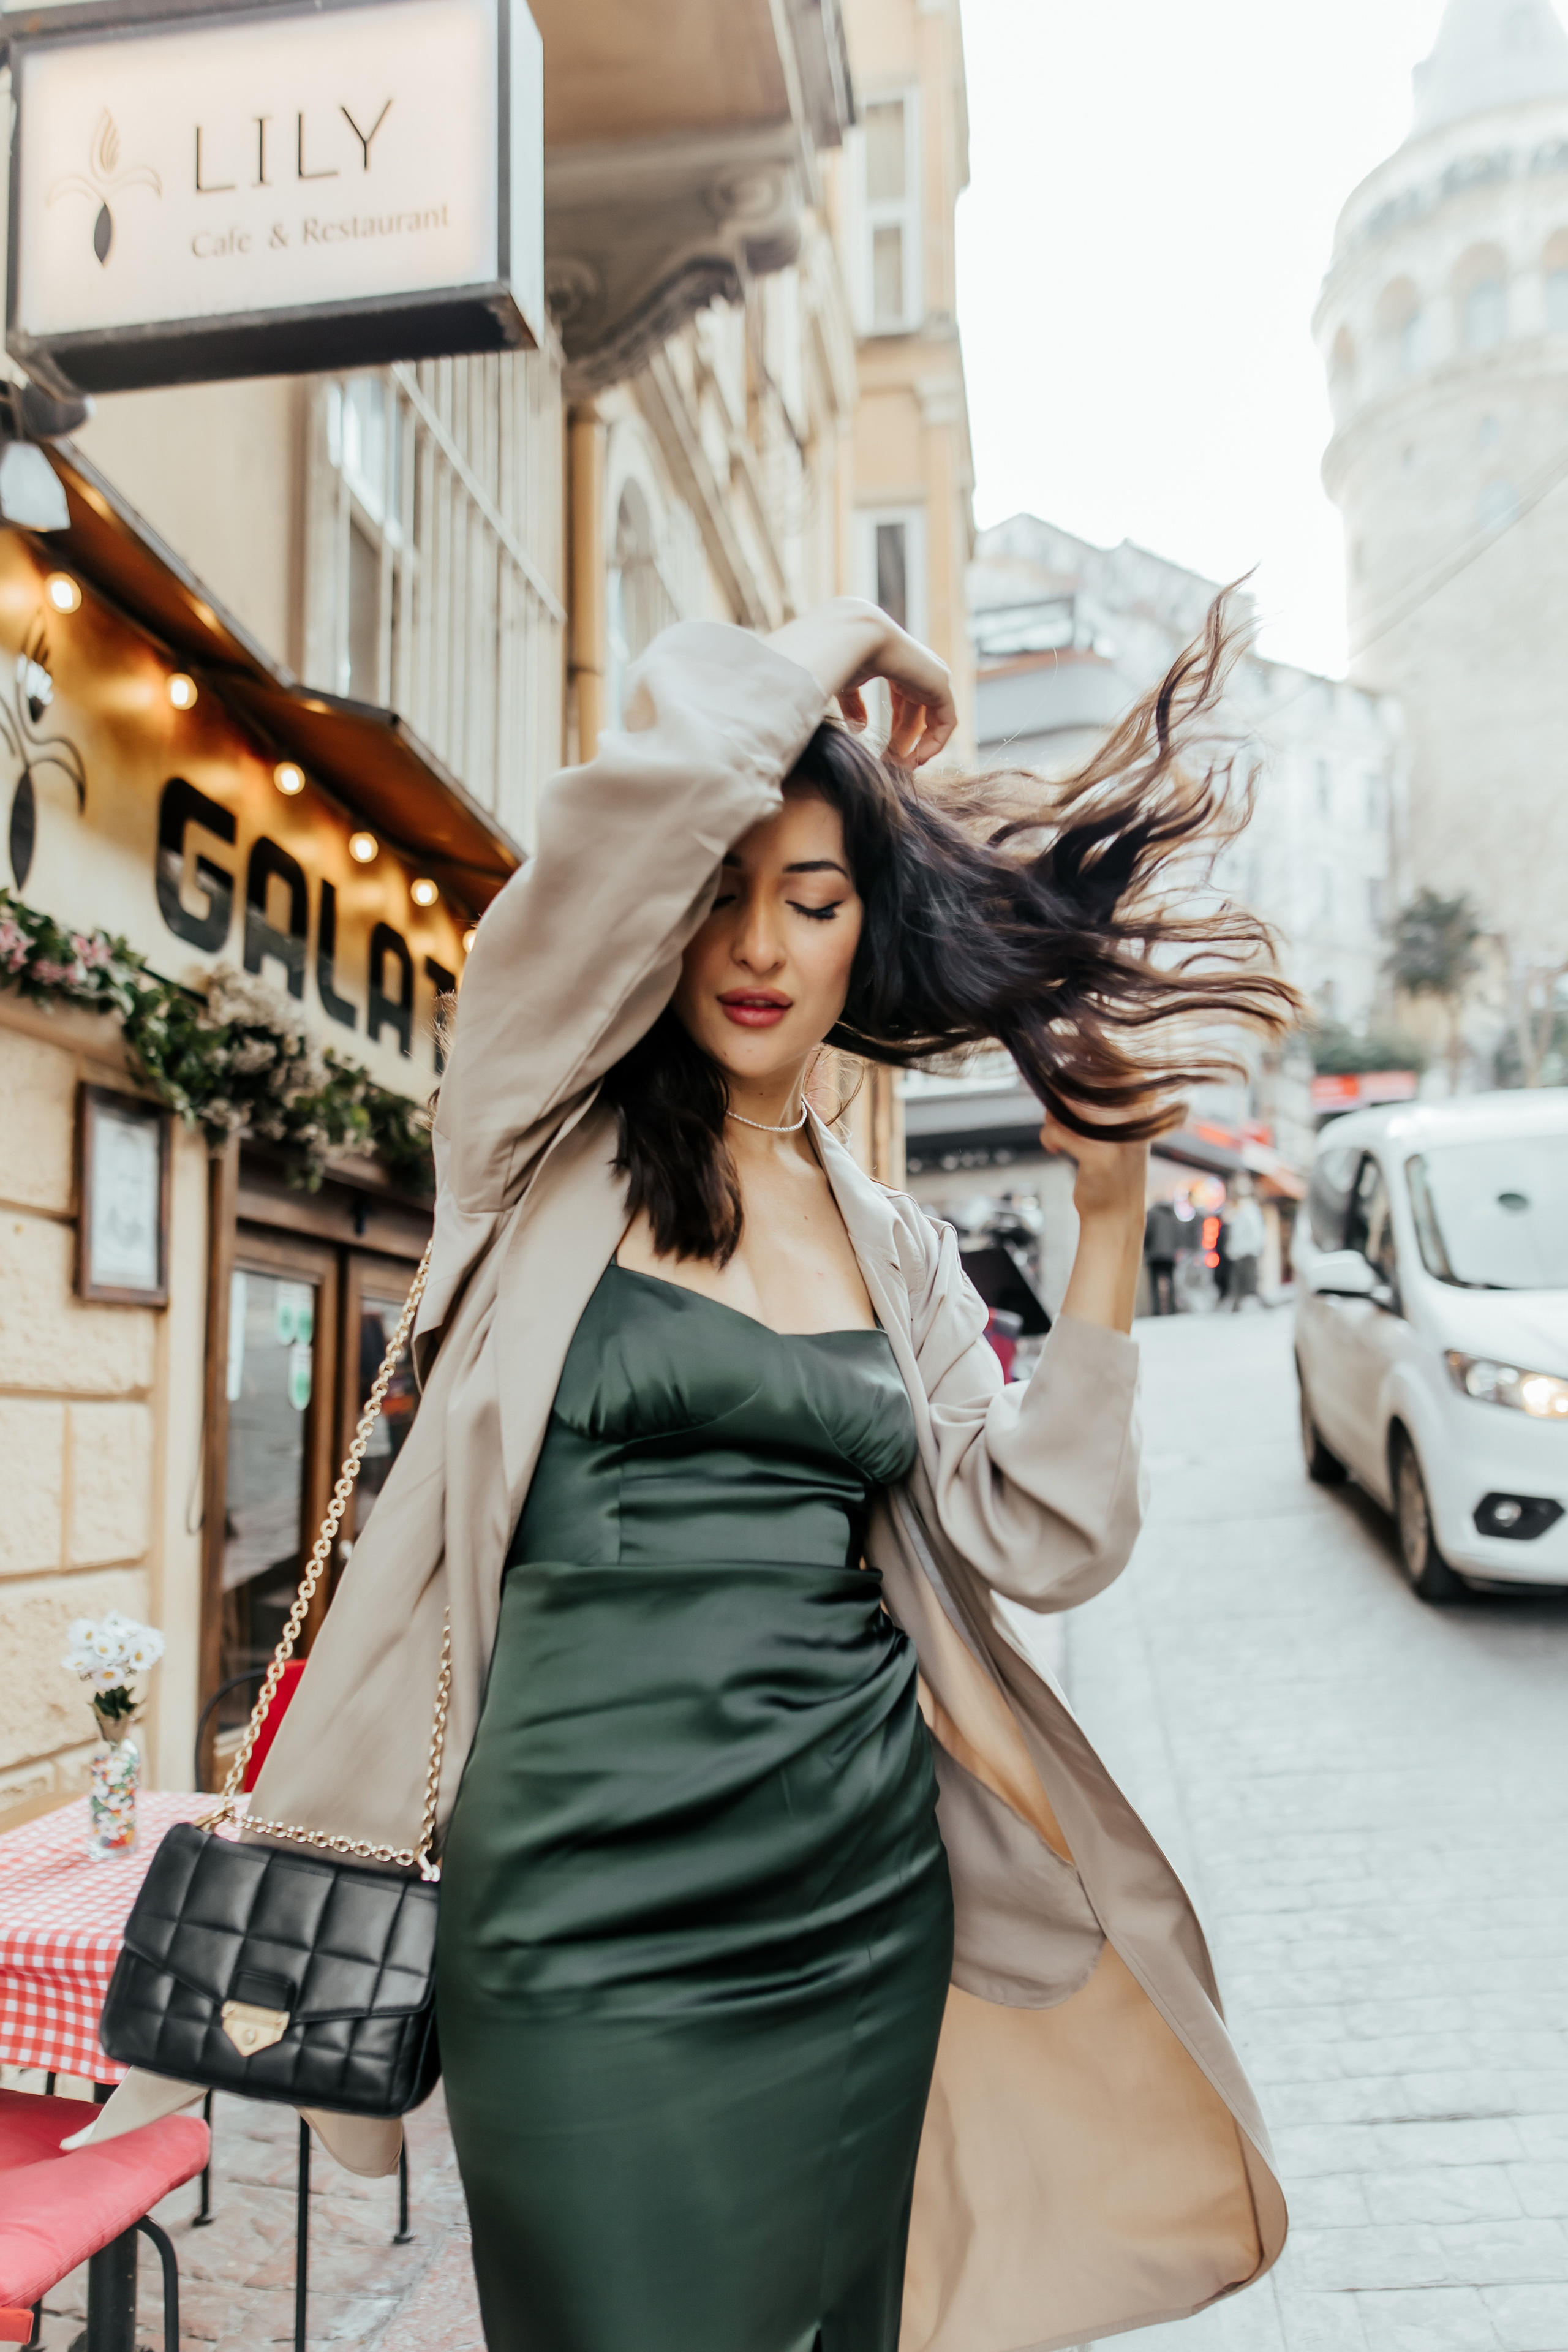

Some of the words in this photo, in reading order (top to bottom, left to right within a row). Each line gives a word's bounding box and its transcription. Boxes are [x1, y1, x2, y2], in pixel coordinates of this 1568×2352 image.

[195, 99, 393, 195] LILY
[192, 227, 251, 258] Cafe
[269, 222, 290, 249] &
[303, 203, 450, 246] Restaurant
